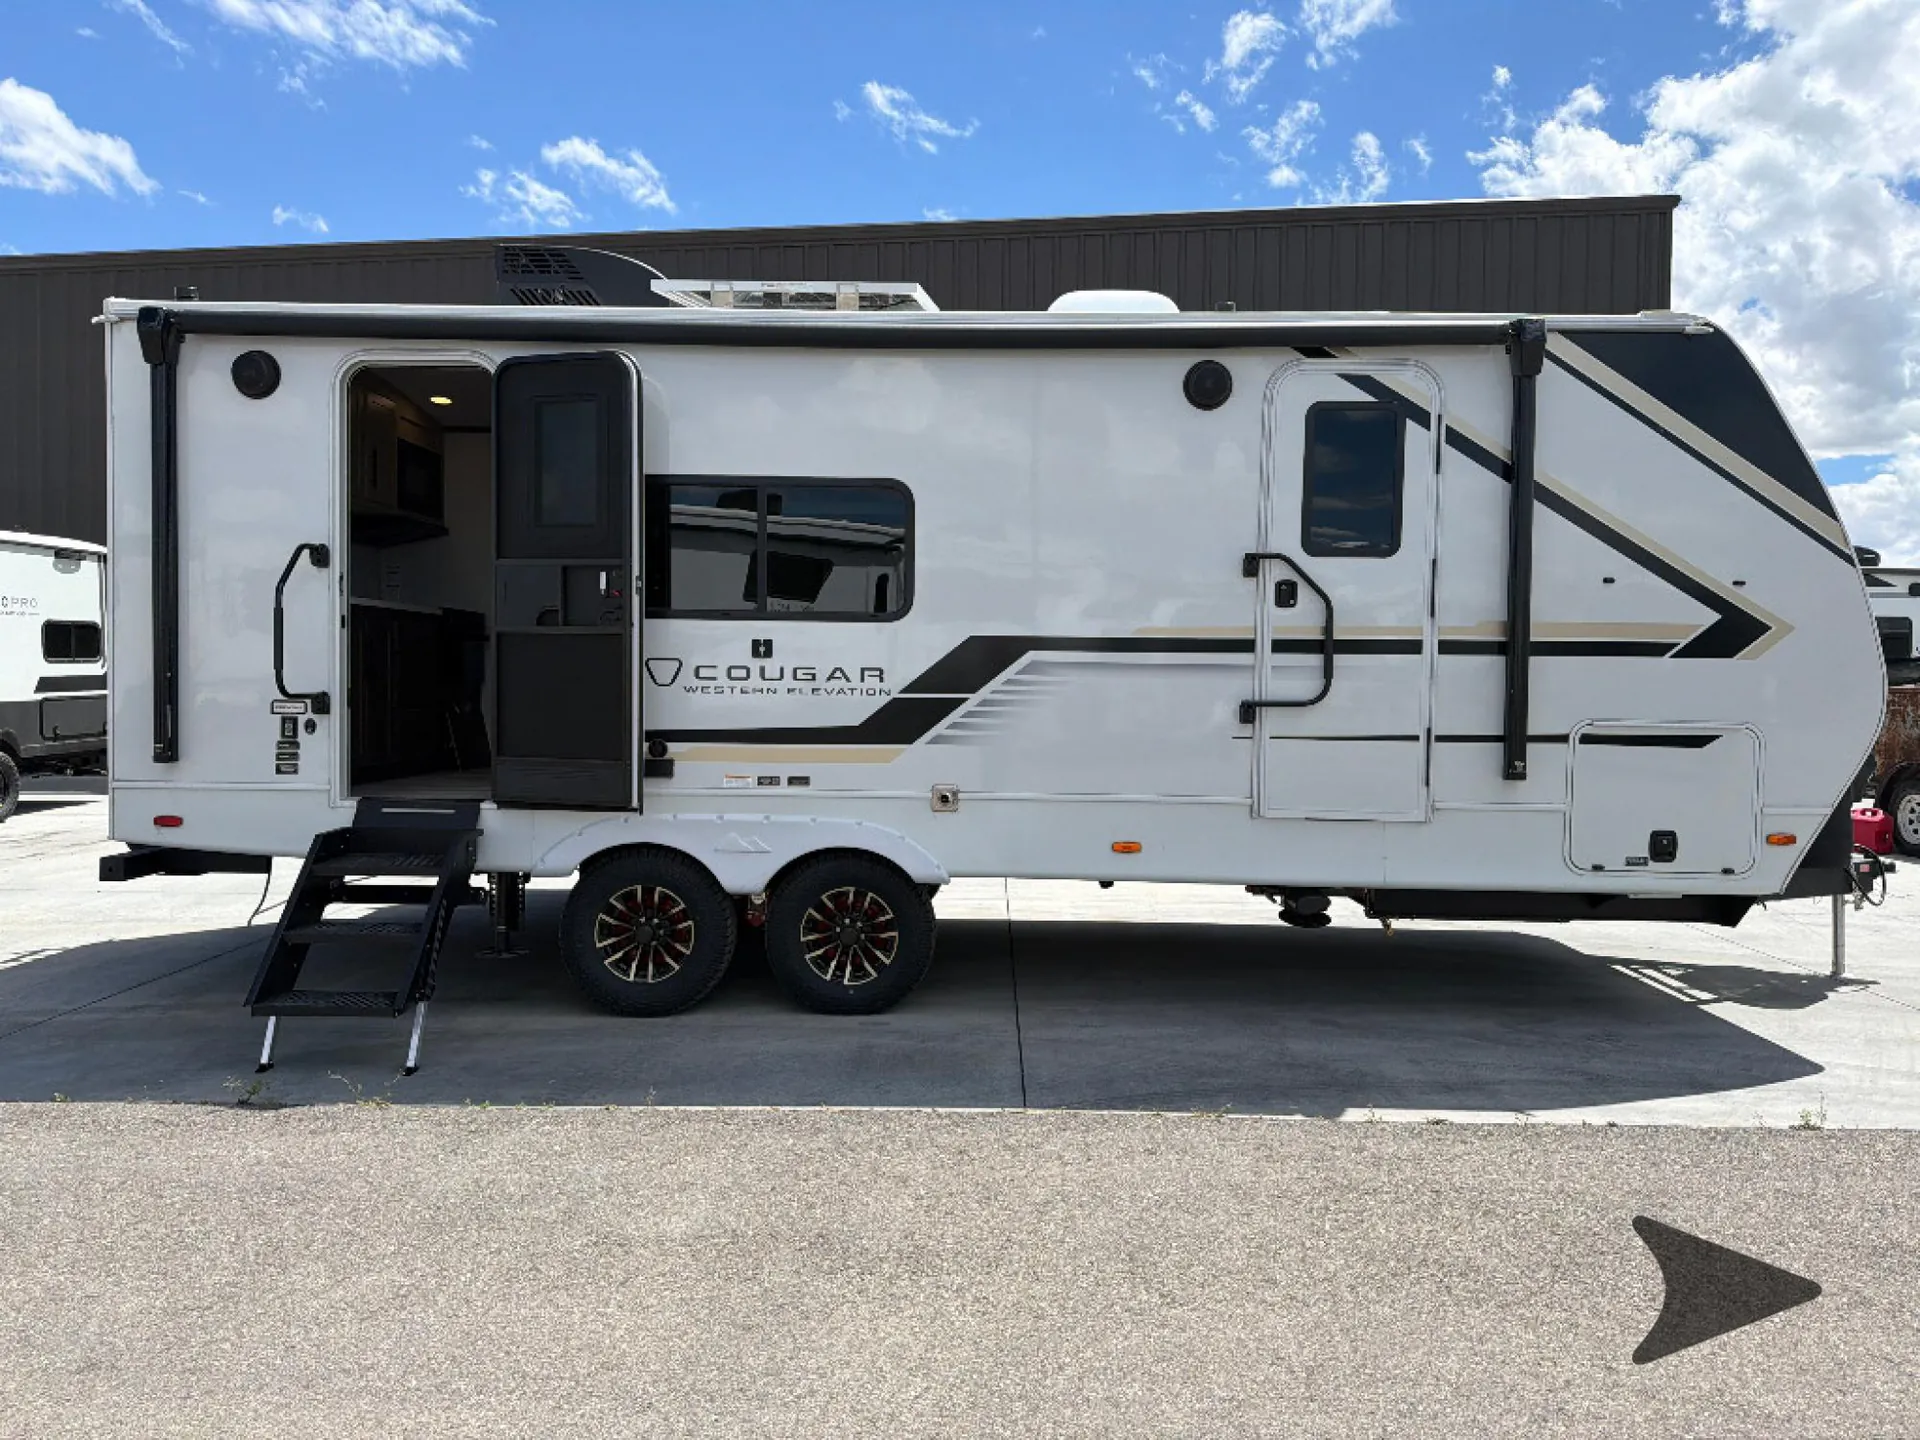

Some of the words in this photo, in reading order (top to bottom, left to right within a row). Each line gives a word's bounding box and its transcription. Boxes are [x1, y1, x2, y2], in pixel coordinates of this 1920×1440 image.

[10, 596, 38, 609] PRO
[693, 664, 885, 684] COUGAR
[683, 685, 778, 695] WESTERN
[786, 687, 892, 697] ELEVATION
